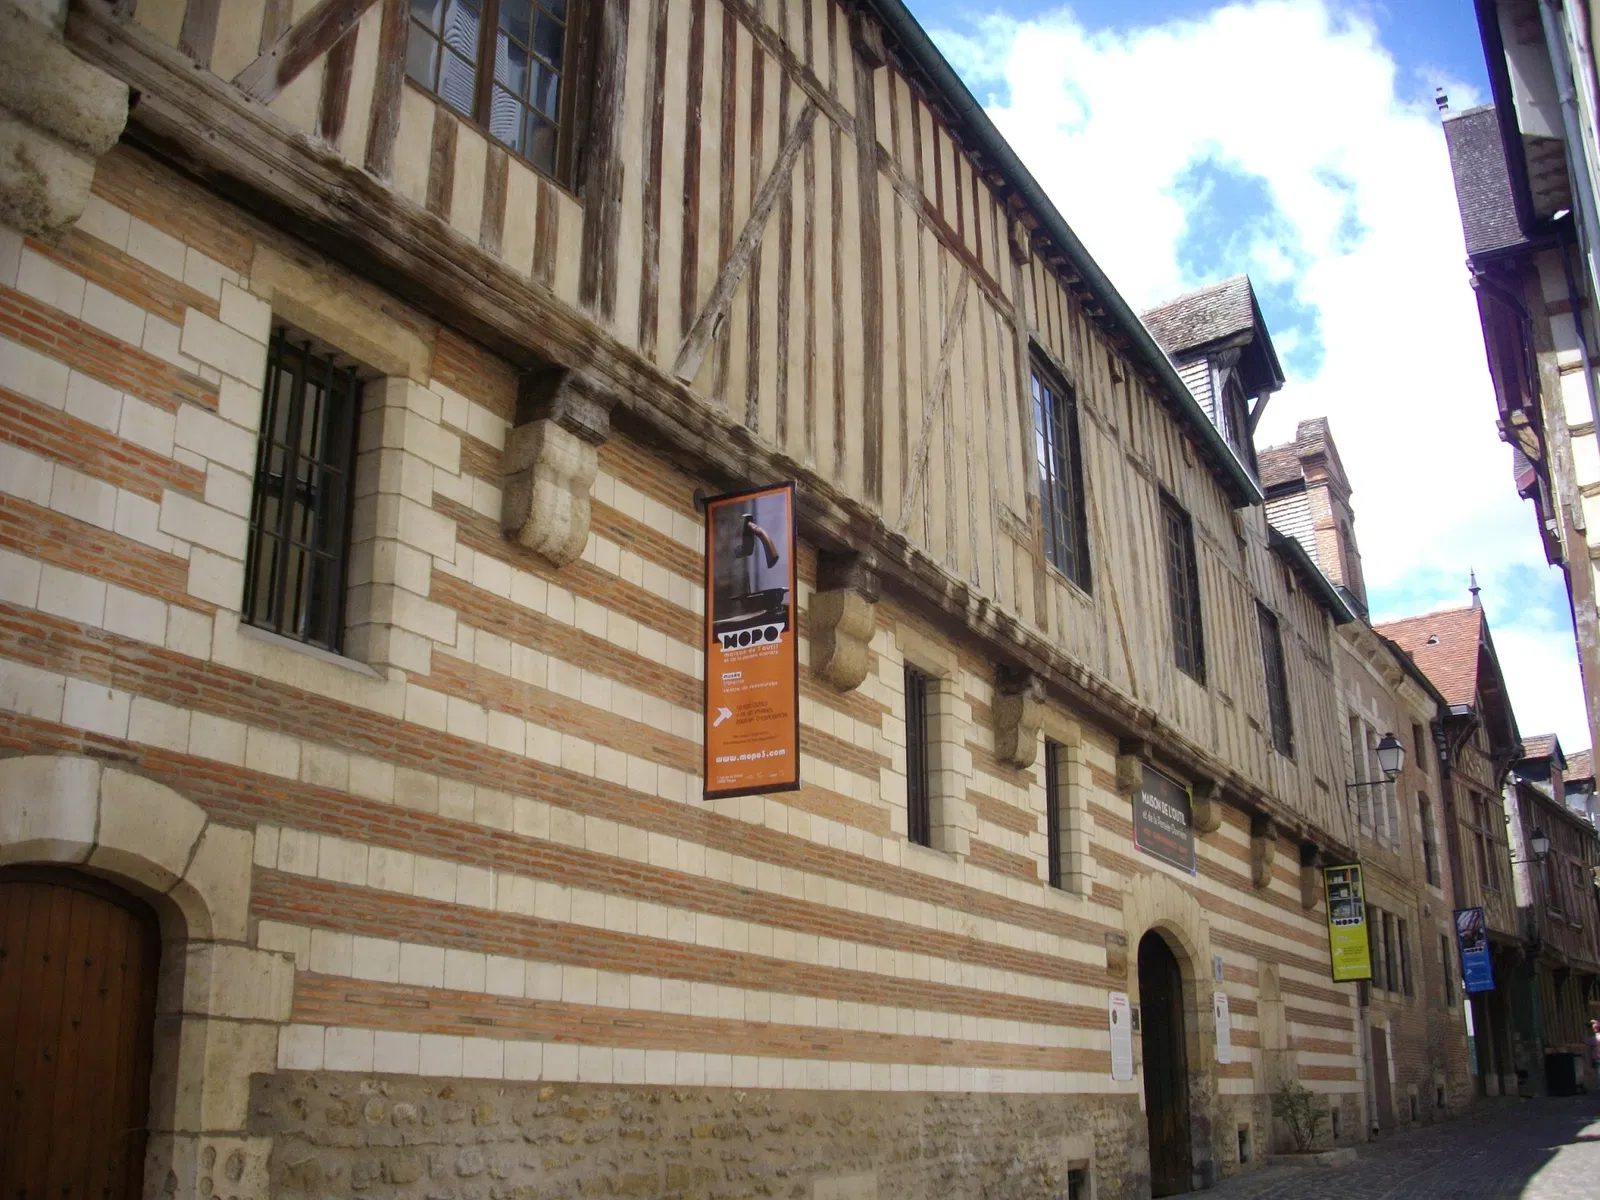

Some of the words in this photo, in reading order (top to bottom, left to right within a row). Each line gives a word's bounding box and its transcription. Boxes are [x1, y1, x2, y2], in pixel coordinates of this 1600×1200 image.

[724, 626, 779, 649] MOPO
[1141, 790, 1161, 812] MAISON
[1161, 801, 1168, 816] DE
